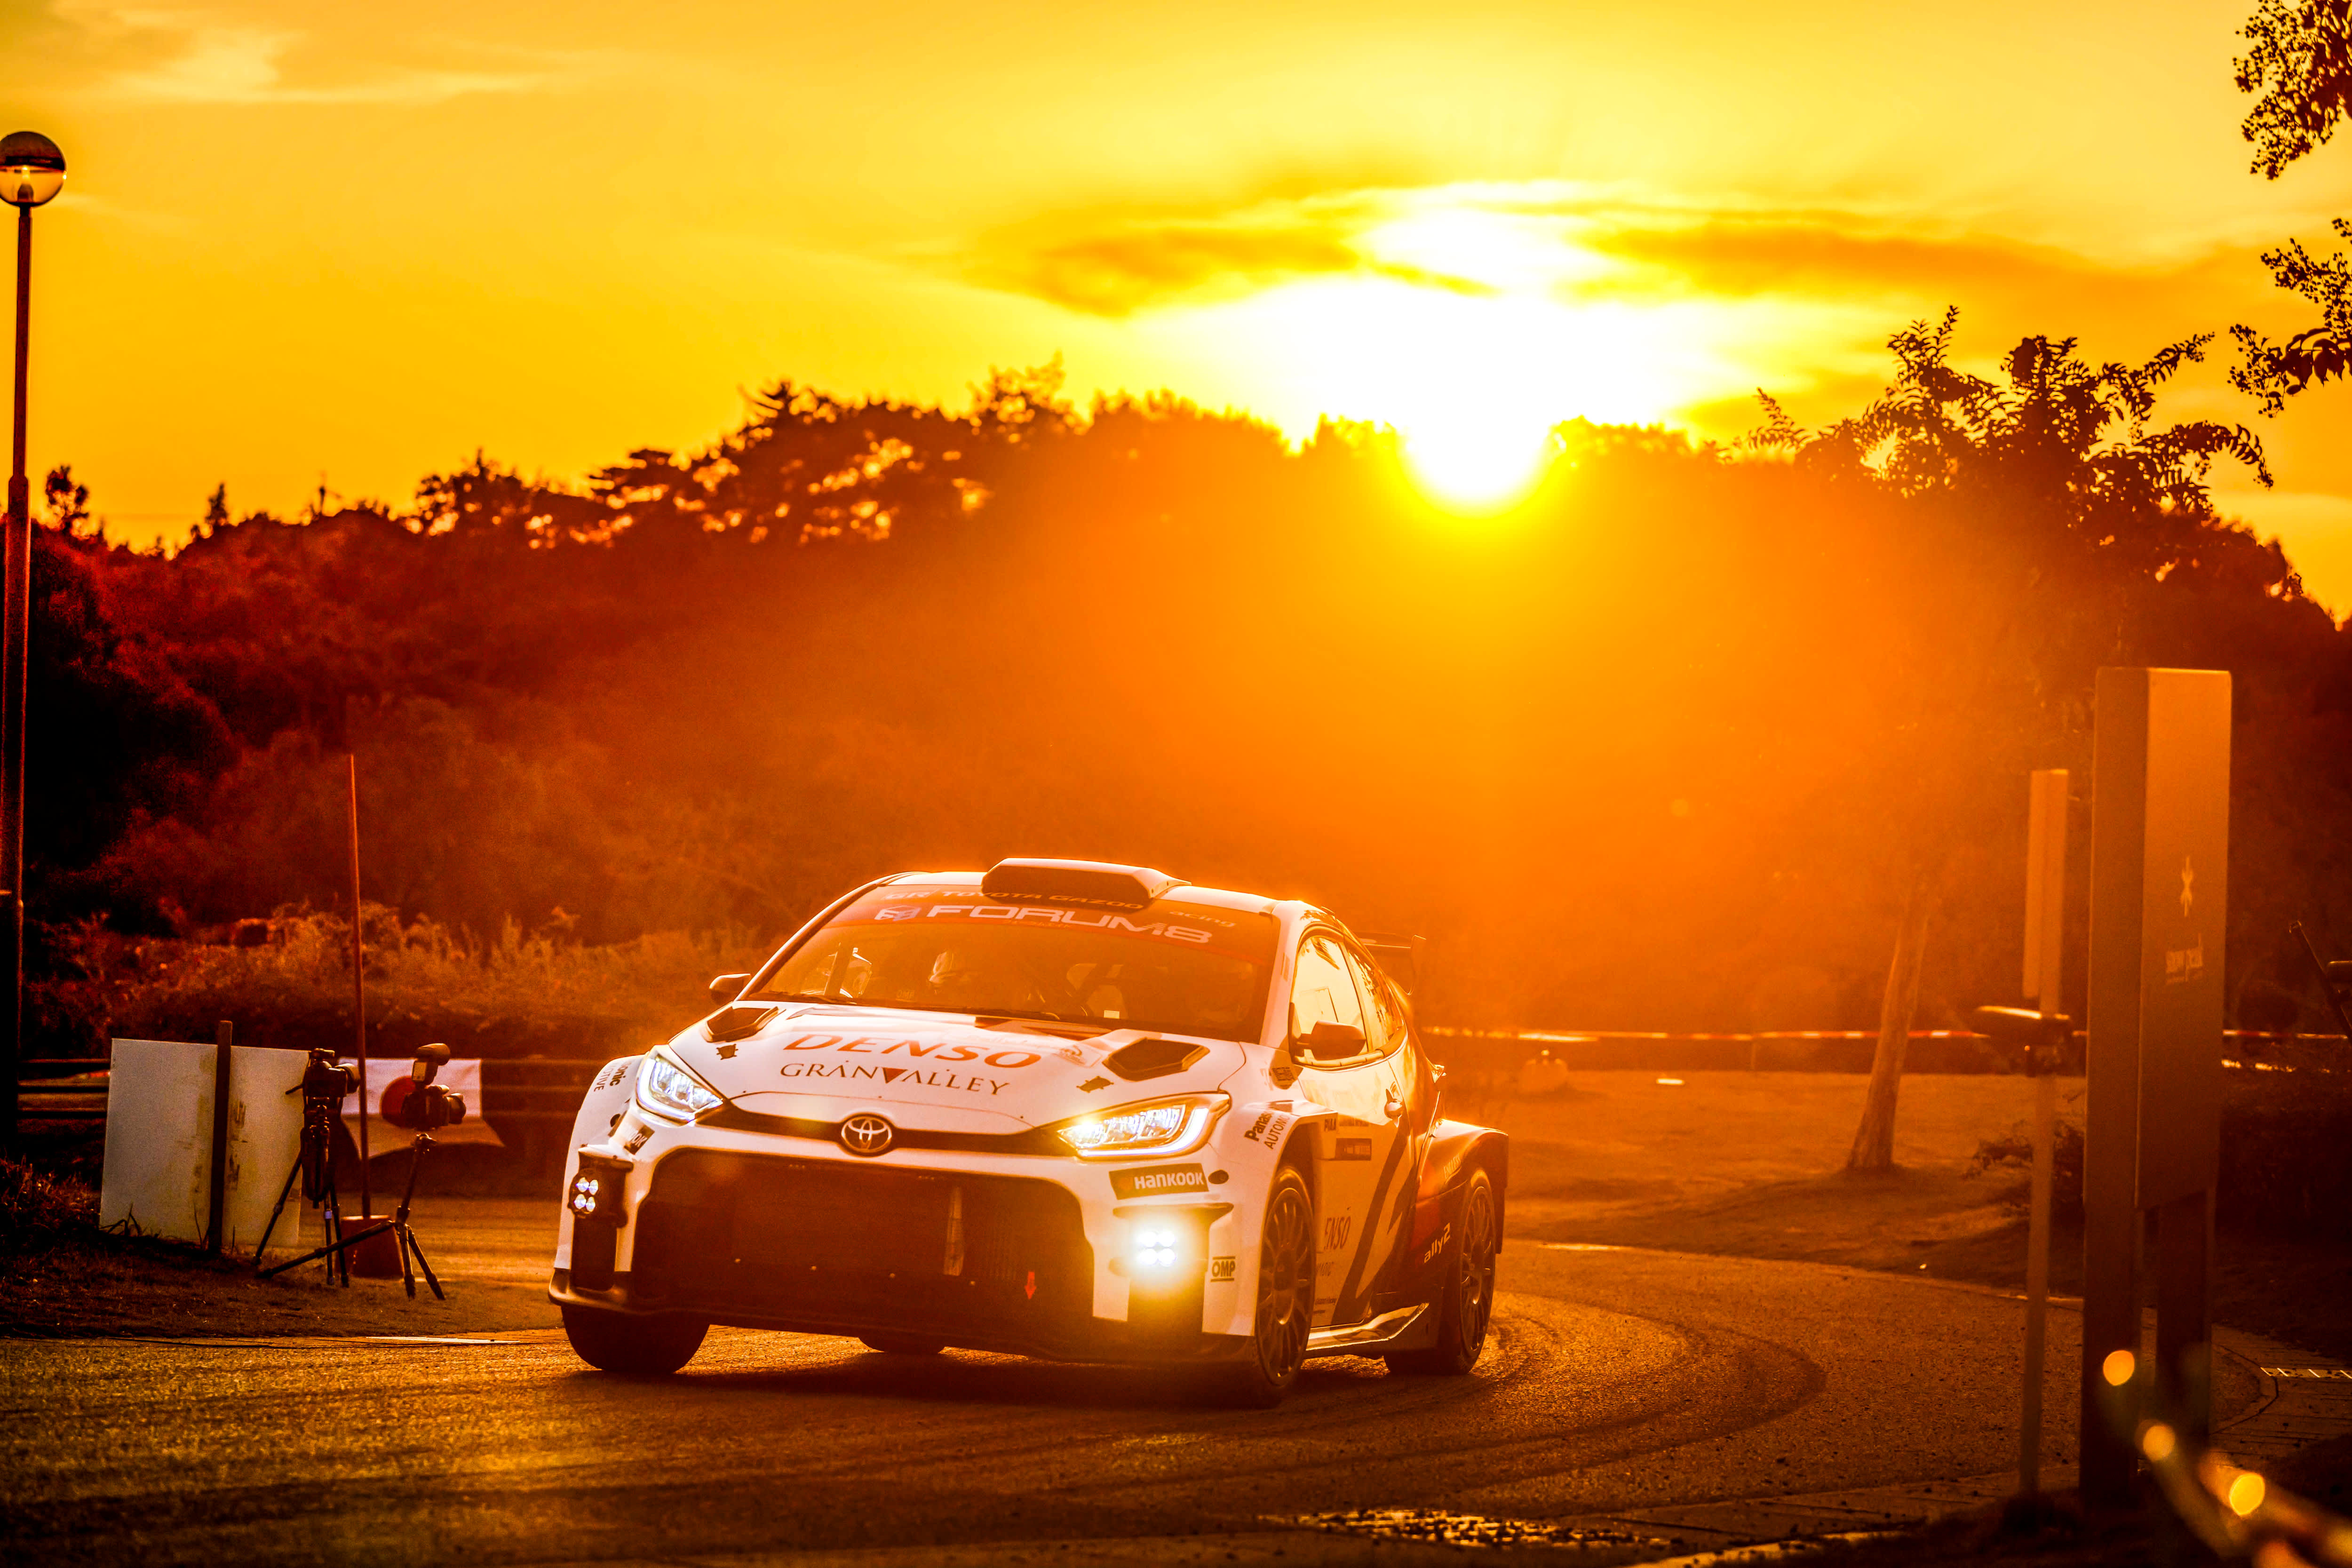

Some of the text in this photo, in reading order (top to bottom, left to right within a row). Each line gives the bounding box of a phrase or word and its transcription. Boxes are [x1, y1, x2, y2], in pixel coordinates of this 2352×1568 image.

[1049, 895, 1144, 909] GAZOO
[926, 905, 1212, 943] FORUM8
[783, 1035, 1041, 1068] DENSO
[1212, 1260, 1236, 1277] OMP
